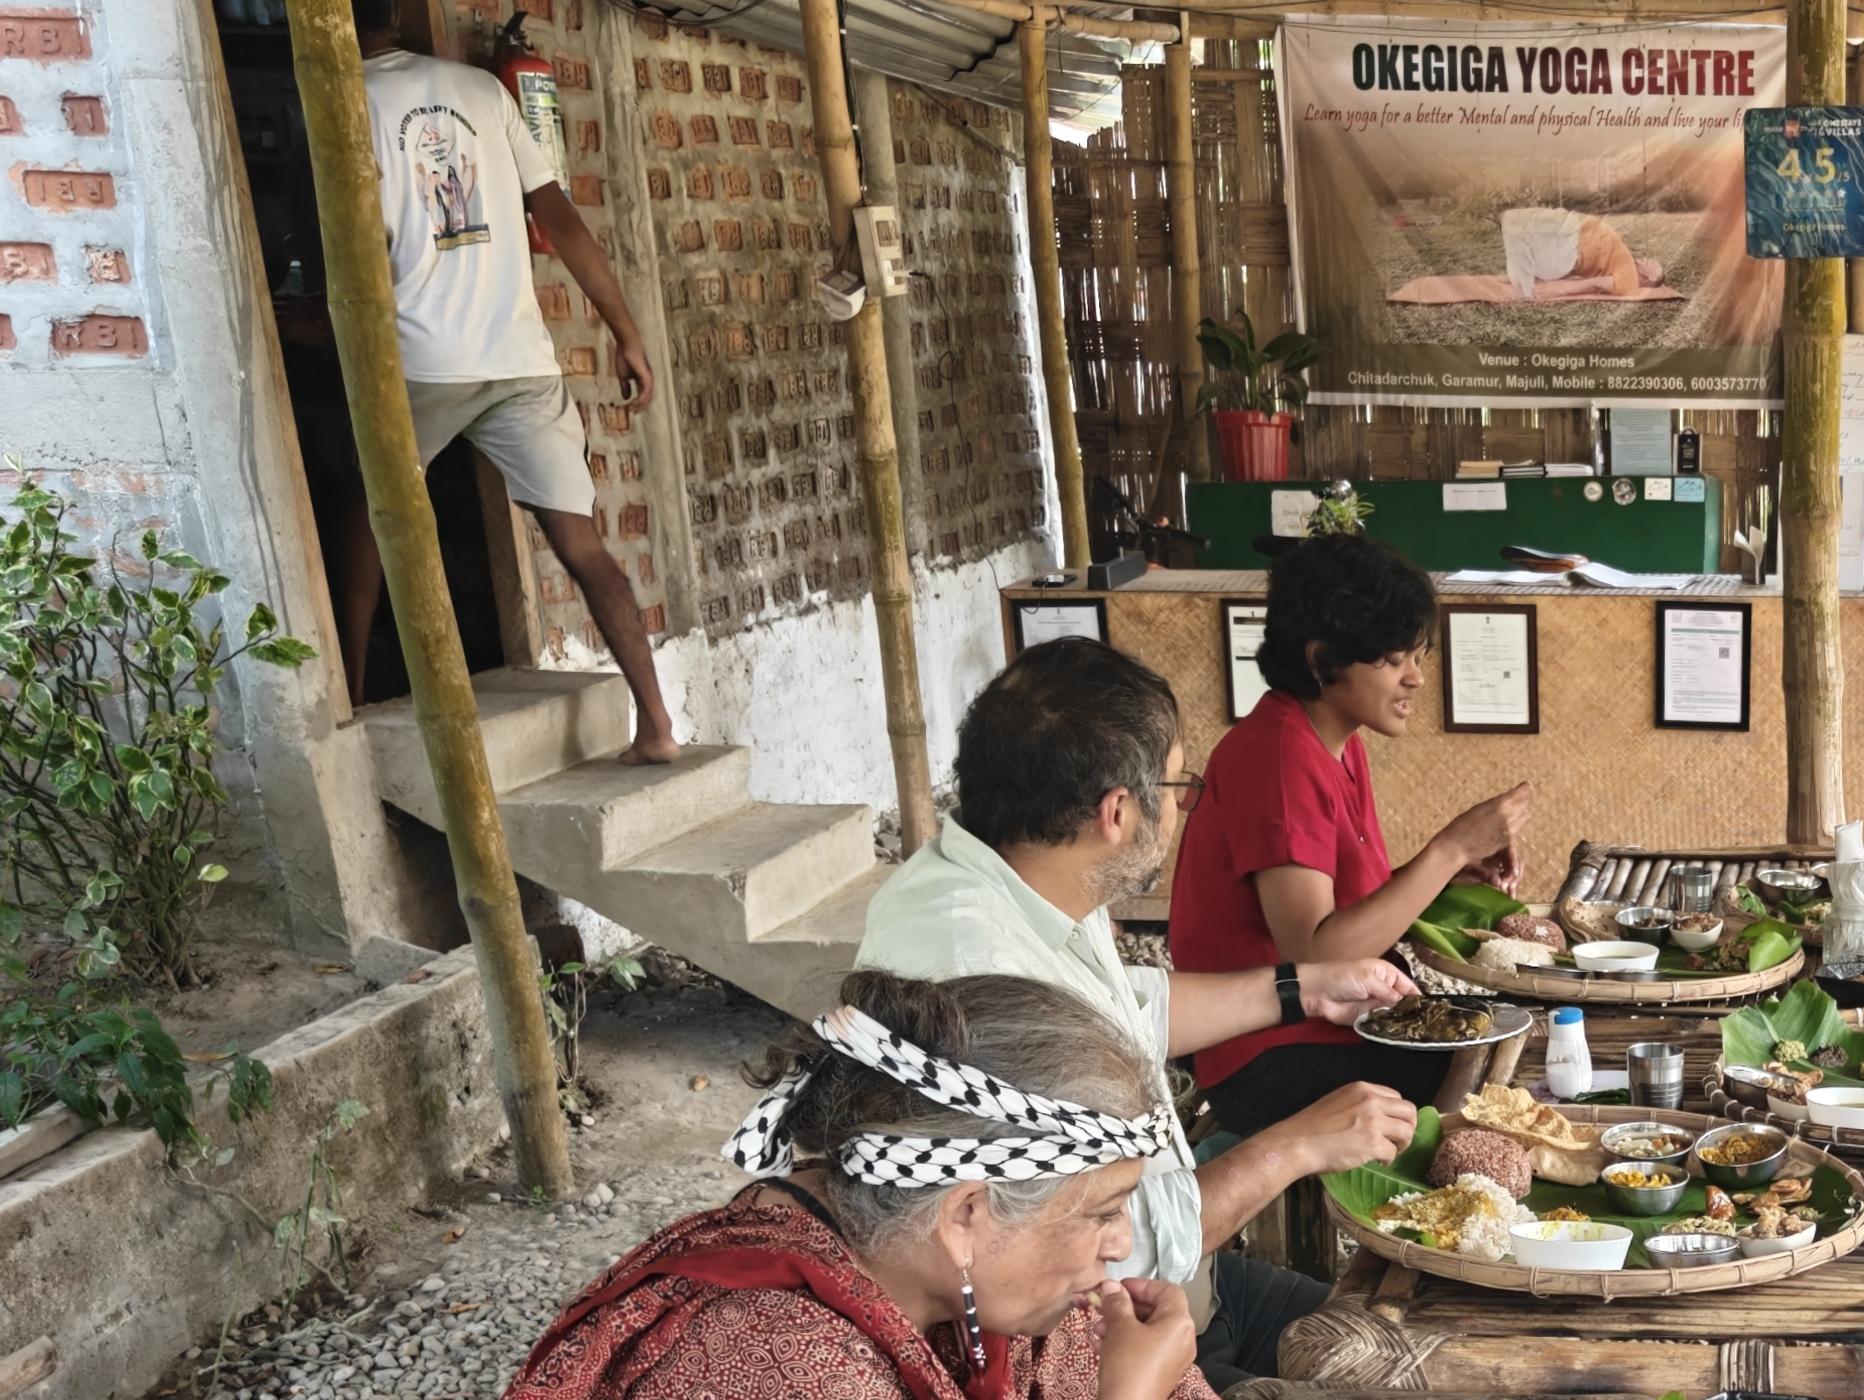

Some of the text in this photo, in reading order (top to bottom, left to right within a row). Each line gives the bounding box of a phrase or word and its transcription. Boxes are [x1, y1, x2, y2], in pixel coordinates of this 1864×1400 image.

[1353, 44, 1754, 95] OKEGIGA YOGA CENTRE
[1304, 104, 1342, 121] Learn
[1346, 111, 1377, 133] yoga
[1381, 104, 1401, 127] for
[1404, 113, 1414, 122] a
[1417, 103, 1453, 123] better
[1459, 105, 1509, 124] Mental
[1511, 105, 1536, 126] and
[1537, 105, 1594, 135] physical
[1597, 107, 1641, 126] Health
[1646, 107, 1672, 127] and
[1674, 107, 1694, 127] live
[1698, 117, 1729, 137] your
[1825, 128, 1861, 136] VILLAS
[1478, 352, 1520, 366] Venue
[1531, 353, 1586, 371] Okegiga
[1589, 355, 1635, 368] Homes
[1348, 371, 1439, 388] Chitadarchuk,
[1441, 373, 1502, 389] Garamur,
[1505, 374, 1545, 391] Majuli,
[1552, 375, 1596, 389] Mobile
[1607, 375, 1687, 391] 8822390306,
[1691, 376, 1766, 391] 6003573770
